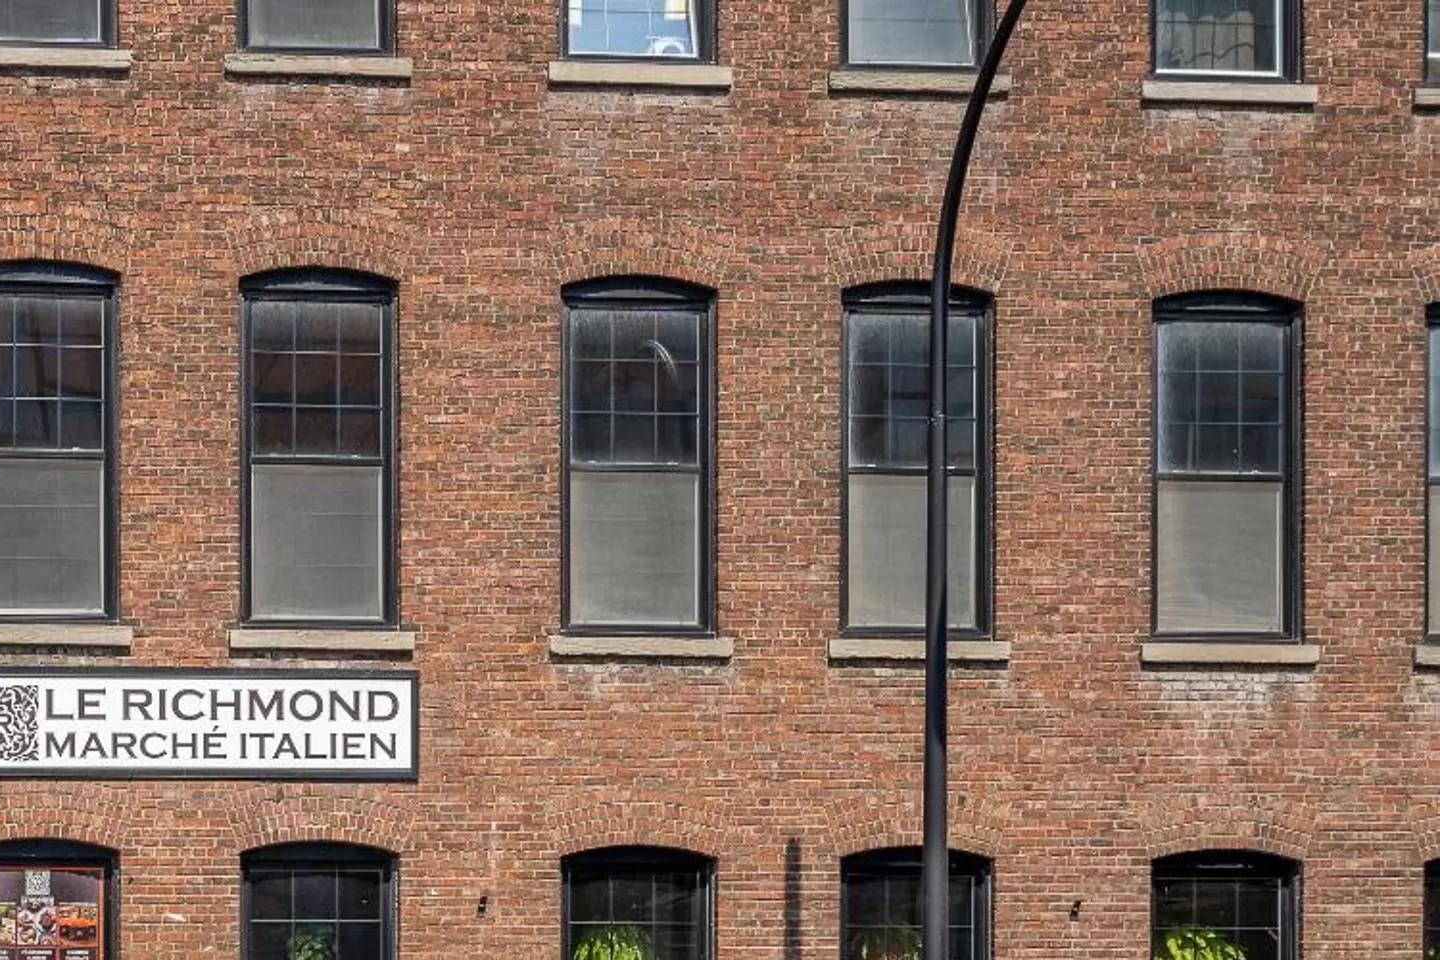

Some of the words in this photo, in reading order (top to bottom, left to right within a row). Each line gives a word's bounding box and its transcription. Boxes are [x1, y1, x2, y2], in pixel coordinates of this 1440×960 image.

[45, 688, 107, 721] LE
[121, 688, 400, 722] RICHMOND
[44, 725, 228, 760] MARCHÉ
[239, 732, 397, 760] ITALIEN
